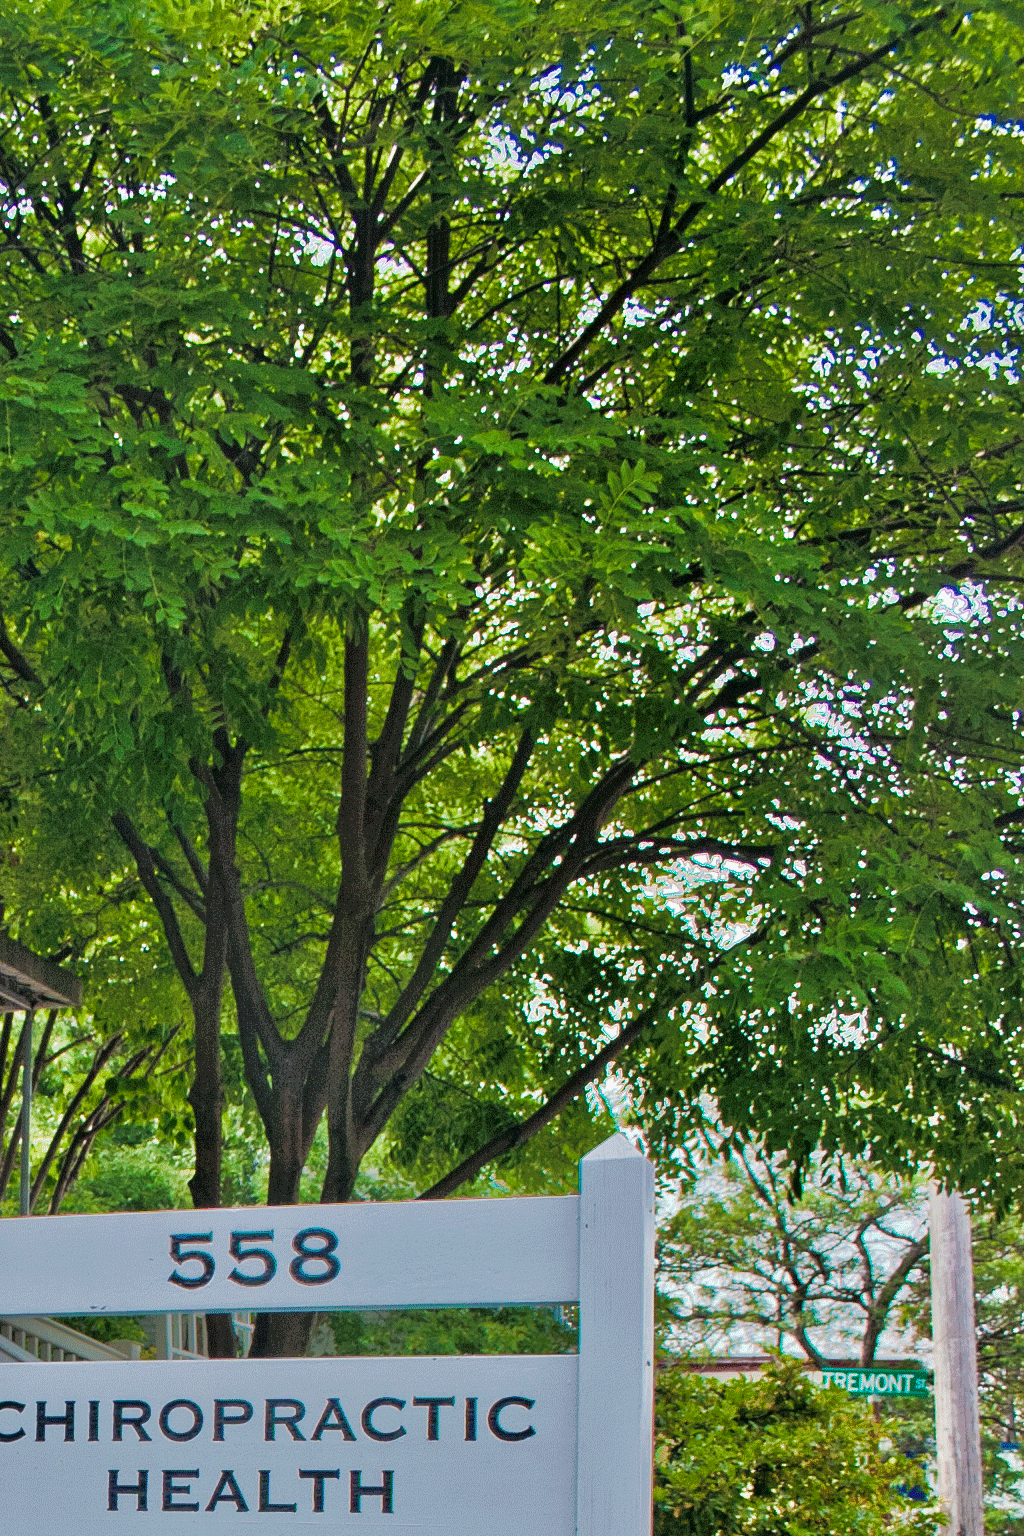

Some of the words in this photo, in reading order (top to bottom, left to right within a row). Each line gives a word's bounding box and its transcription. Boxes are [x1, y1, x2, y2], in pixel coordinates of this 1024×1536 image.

[167, 1227, 341, 1289] 558
[821, 1372, 915, 1393] TREMONT
[107, 1468, 395, 1514] HEALTH
